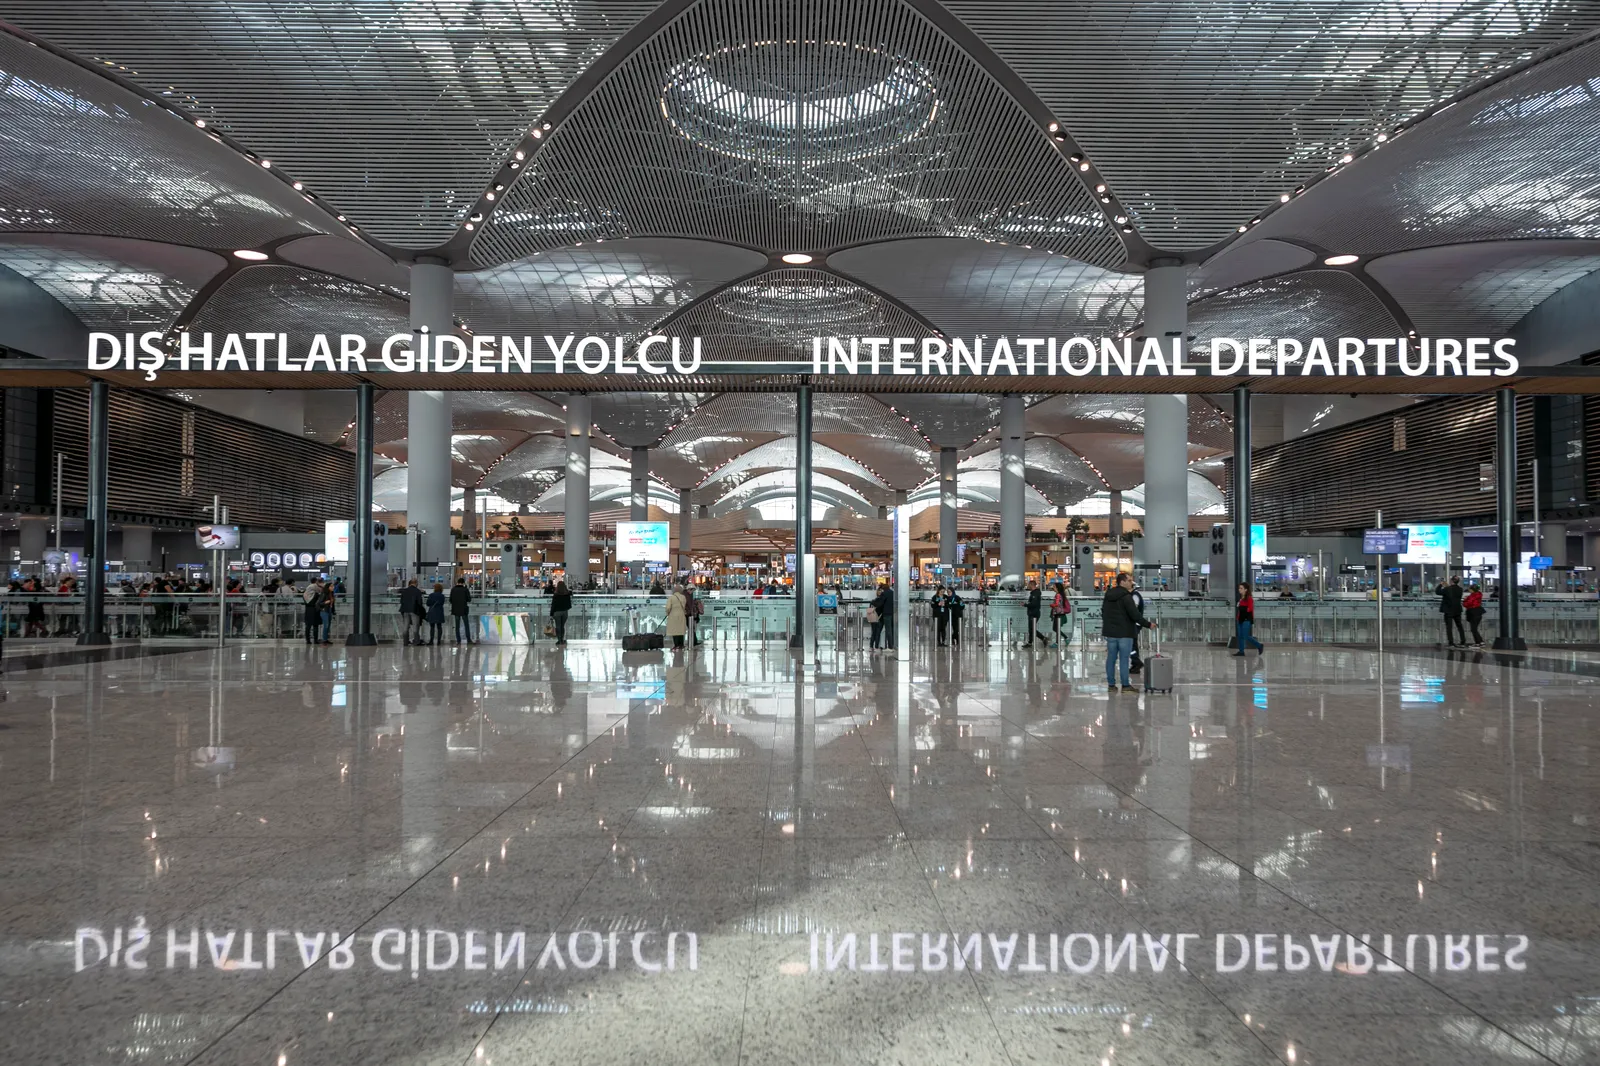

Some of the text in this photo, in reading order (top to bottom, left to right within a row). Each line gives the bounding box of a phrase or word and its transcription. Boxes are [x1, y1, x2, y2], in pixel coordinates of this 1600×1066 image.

[87, 325, 702, 382] DIŞ HATLAR GİDEN YOLCU
[811, 337, 1520, 377] INTERNATIONAL DEPARTURES
